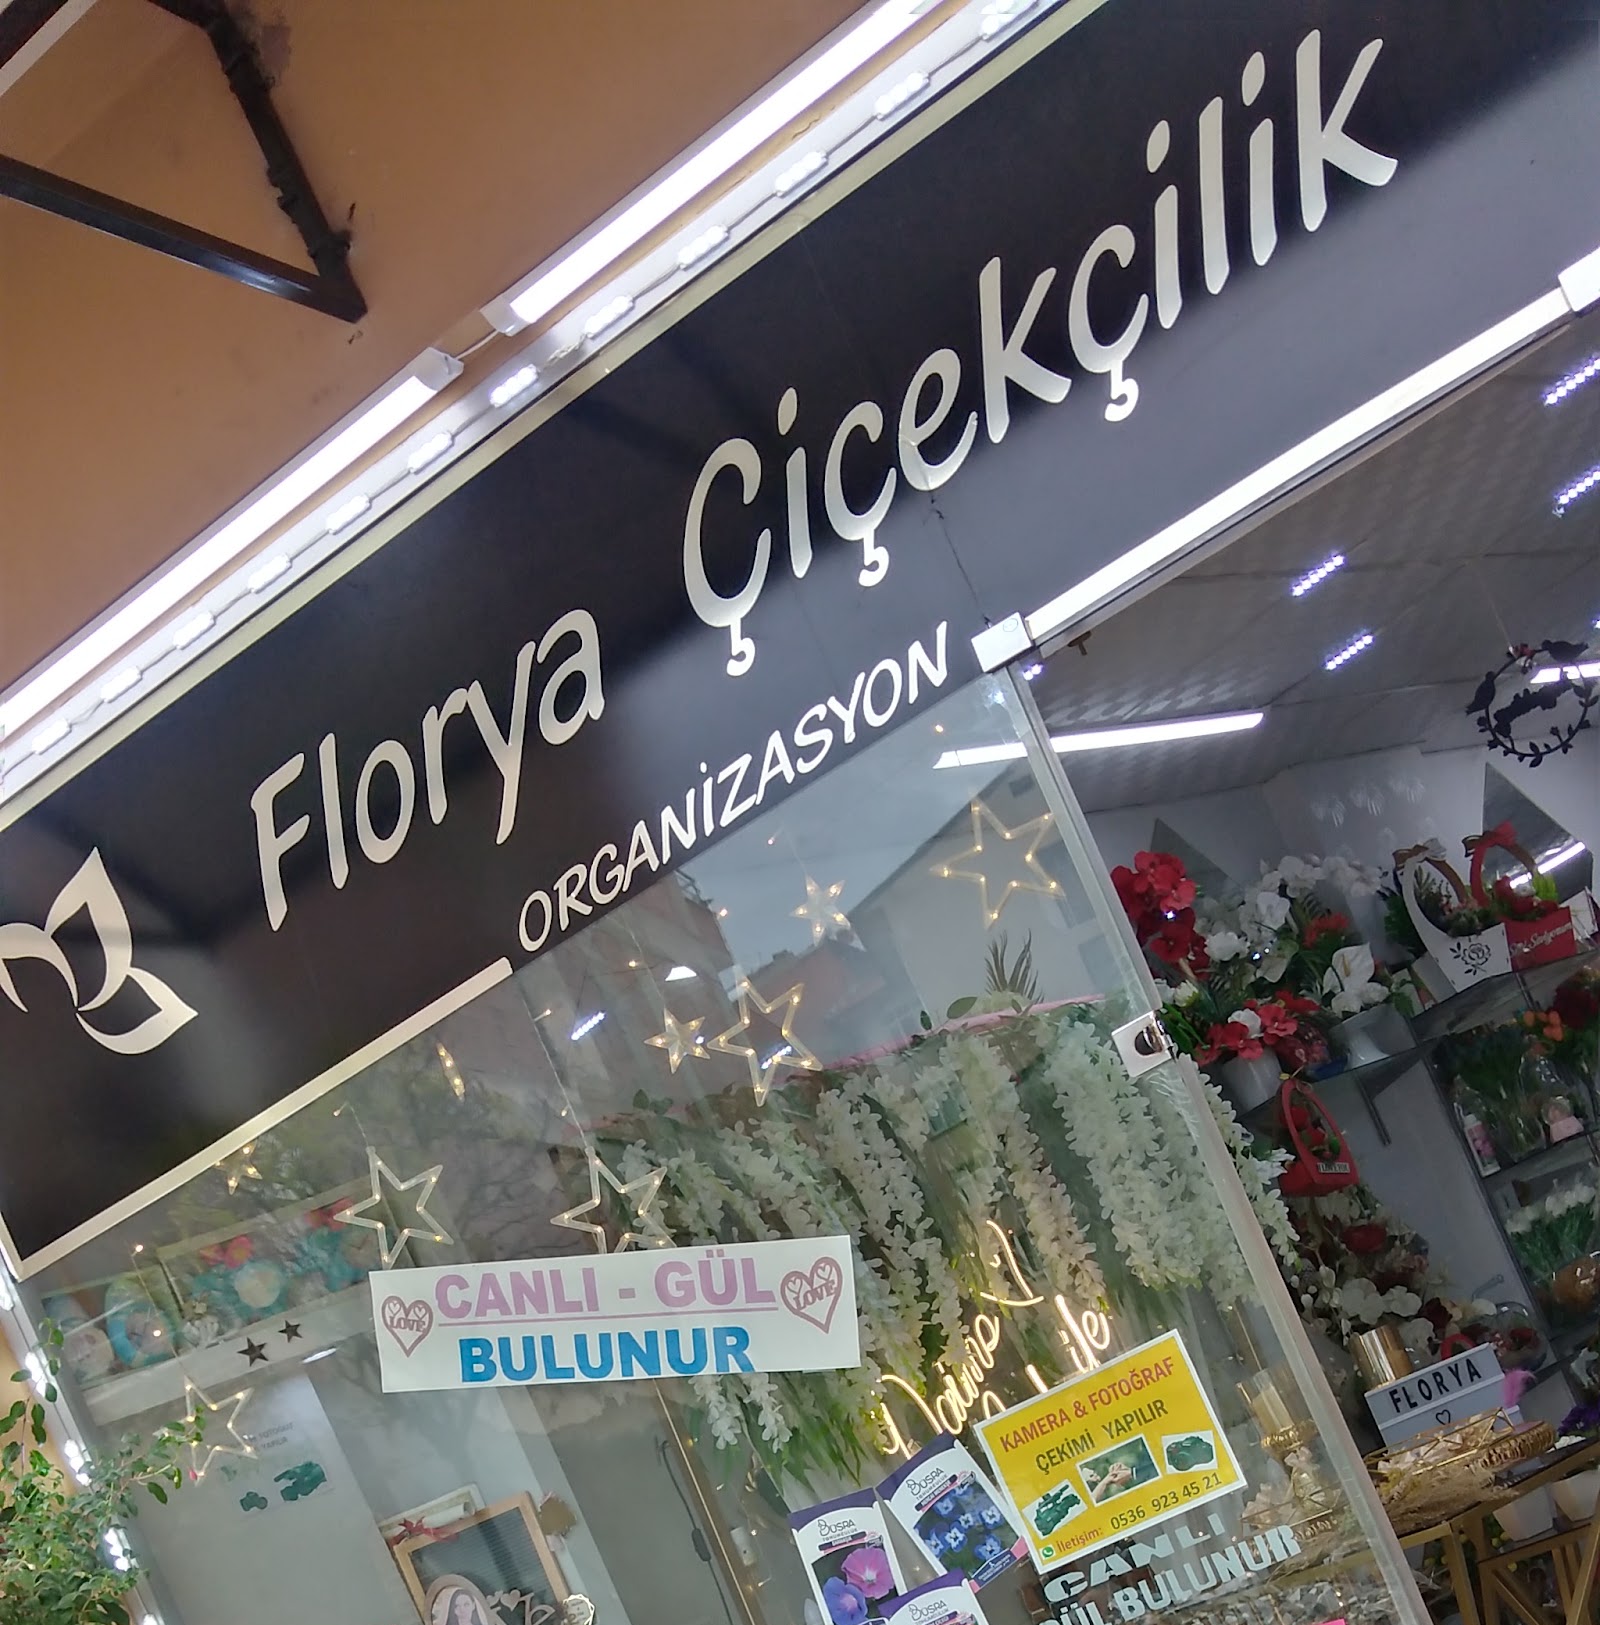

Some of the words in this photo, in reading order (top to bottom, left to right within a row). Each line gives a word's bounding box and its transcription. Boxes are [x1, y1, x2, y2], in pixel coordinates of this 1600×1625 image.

[250, 609, 605, 932] Florya
[682, 28, 1399, 678] Çiçekçilik
[518, 620, 948, 953] ORGANİZASYON
[389, 1315, 426, 1332] LOVE
[435, 1267, 600, 1319] CANLI
[653, 1249, 778, 1308] GÜL
[793, 1279, 836, 1311] LOVE
[459, 1325, 755, 1383] BULUNUR
[1389, 1358, 1483, 1414] FLORYA
[999, 1407, 1072, 1453] KAMERA
[1072, 1399, 1088, 1419] &
[1088, 1356, 1175, 1411] FOTOĞRAF
[1035, 1428, 1096, 1476] ÇEKİMİ
[1101, 1398, 1169, 1441] YAPILIR
[1056, 1527, 1104, 1553] İletişim:
[1110, 1504, 1146, 1531] 0536
[1151, 1489, 1180, 1513] 923
[1182, 1484, 1201, 1499] 45
[1202, 1472, 1222, 1491] 21
[1043, 1512, 1226, 1602] CANLI
[1113, 1524, 1301, 1622] BULUNUR
